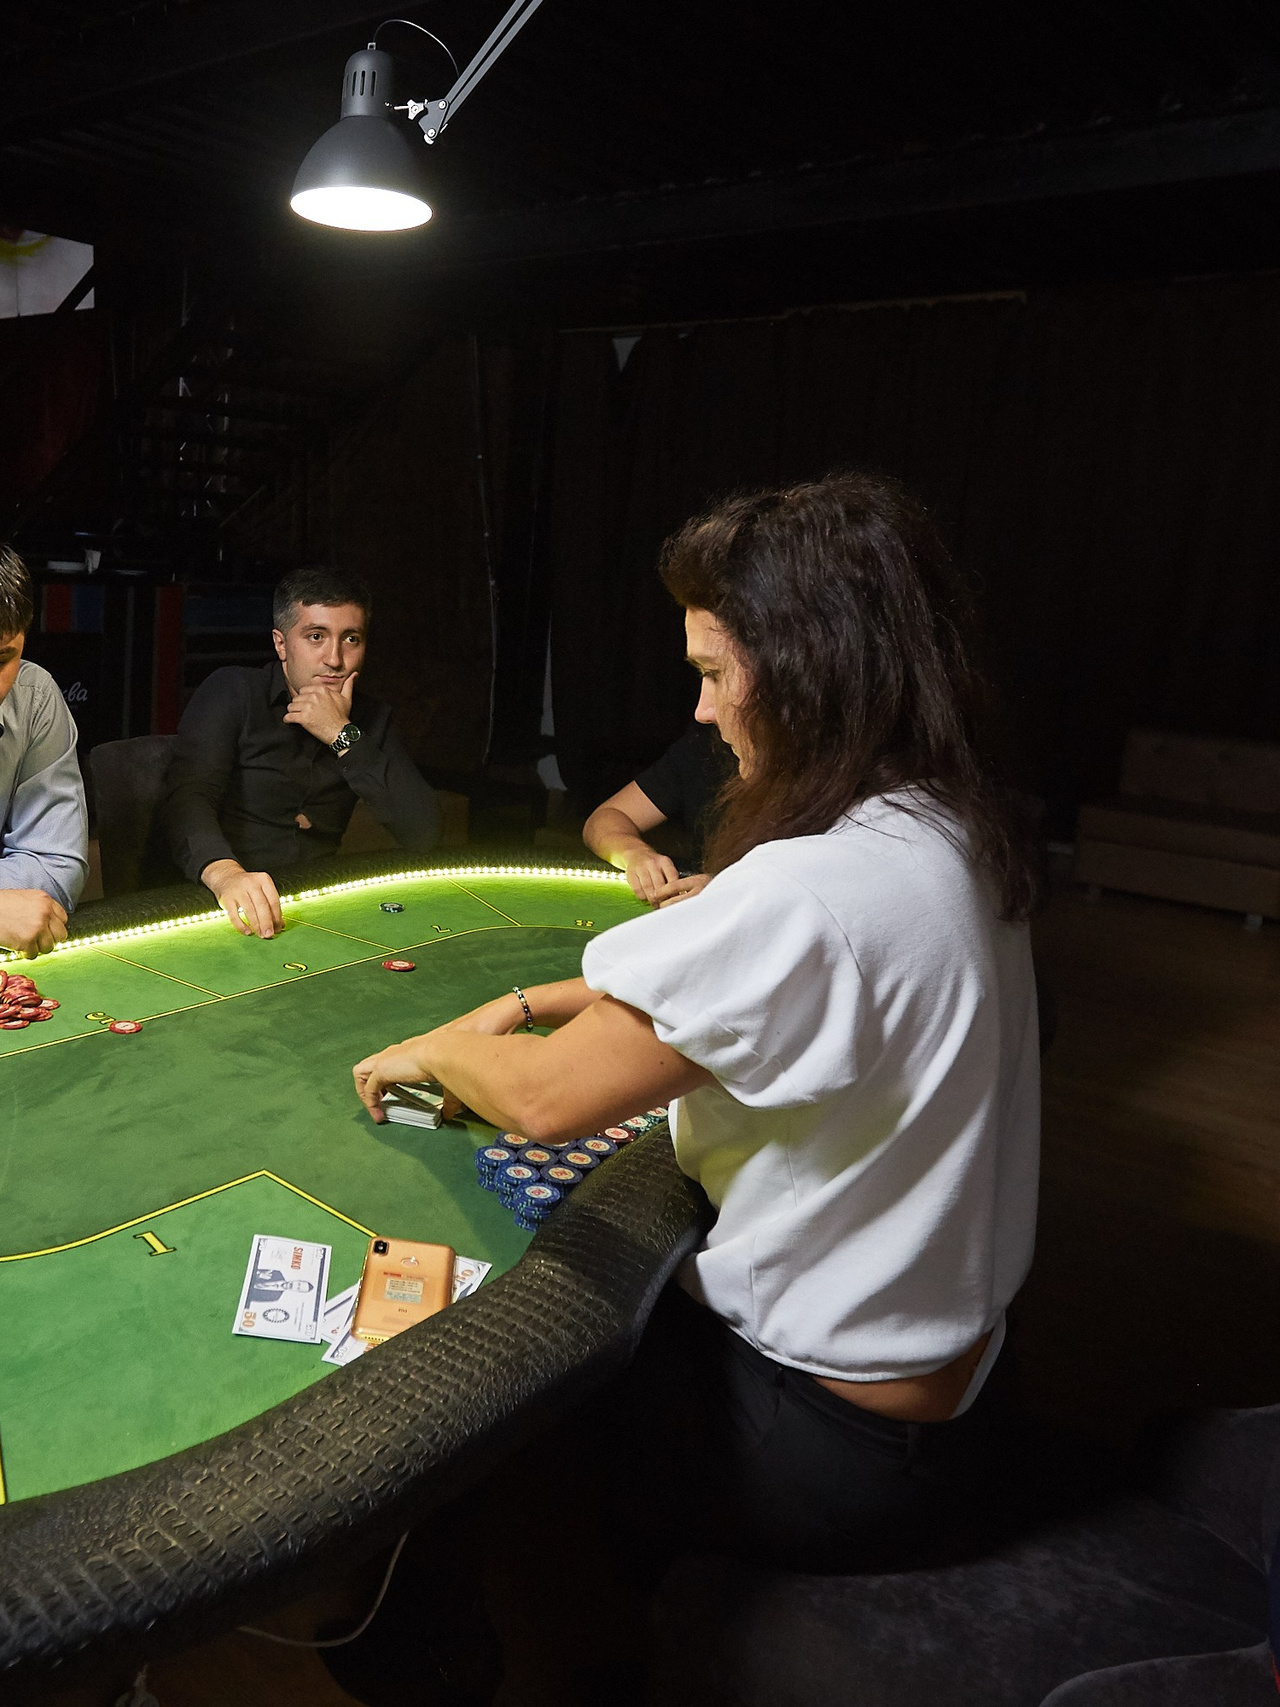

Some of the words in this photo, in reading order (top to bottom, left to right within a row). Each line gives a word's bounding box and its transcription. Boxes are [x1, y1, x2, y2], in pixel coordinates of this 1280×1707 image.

[431, 925, 452, 933] 7
[133, 1231, 177, 1256] 1
[242, 1311, 257, 1328] 50
